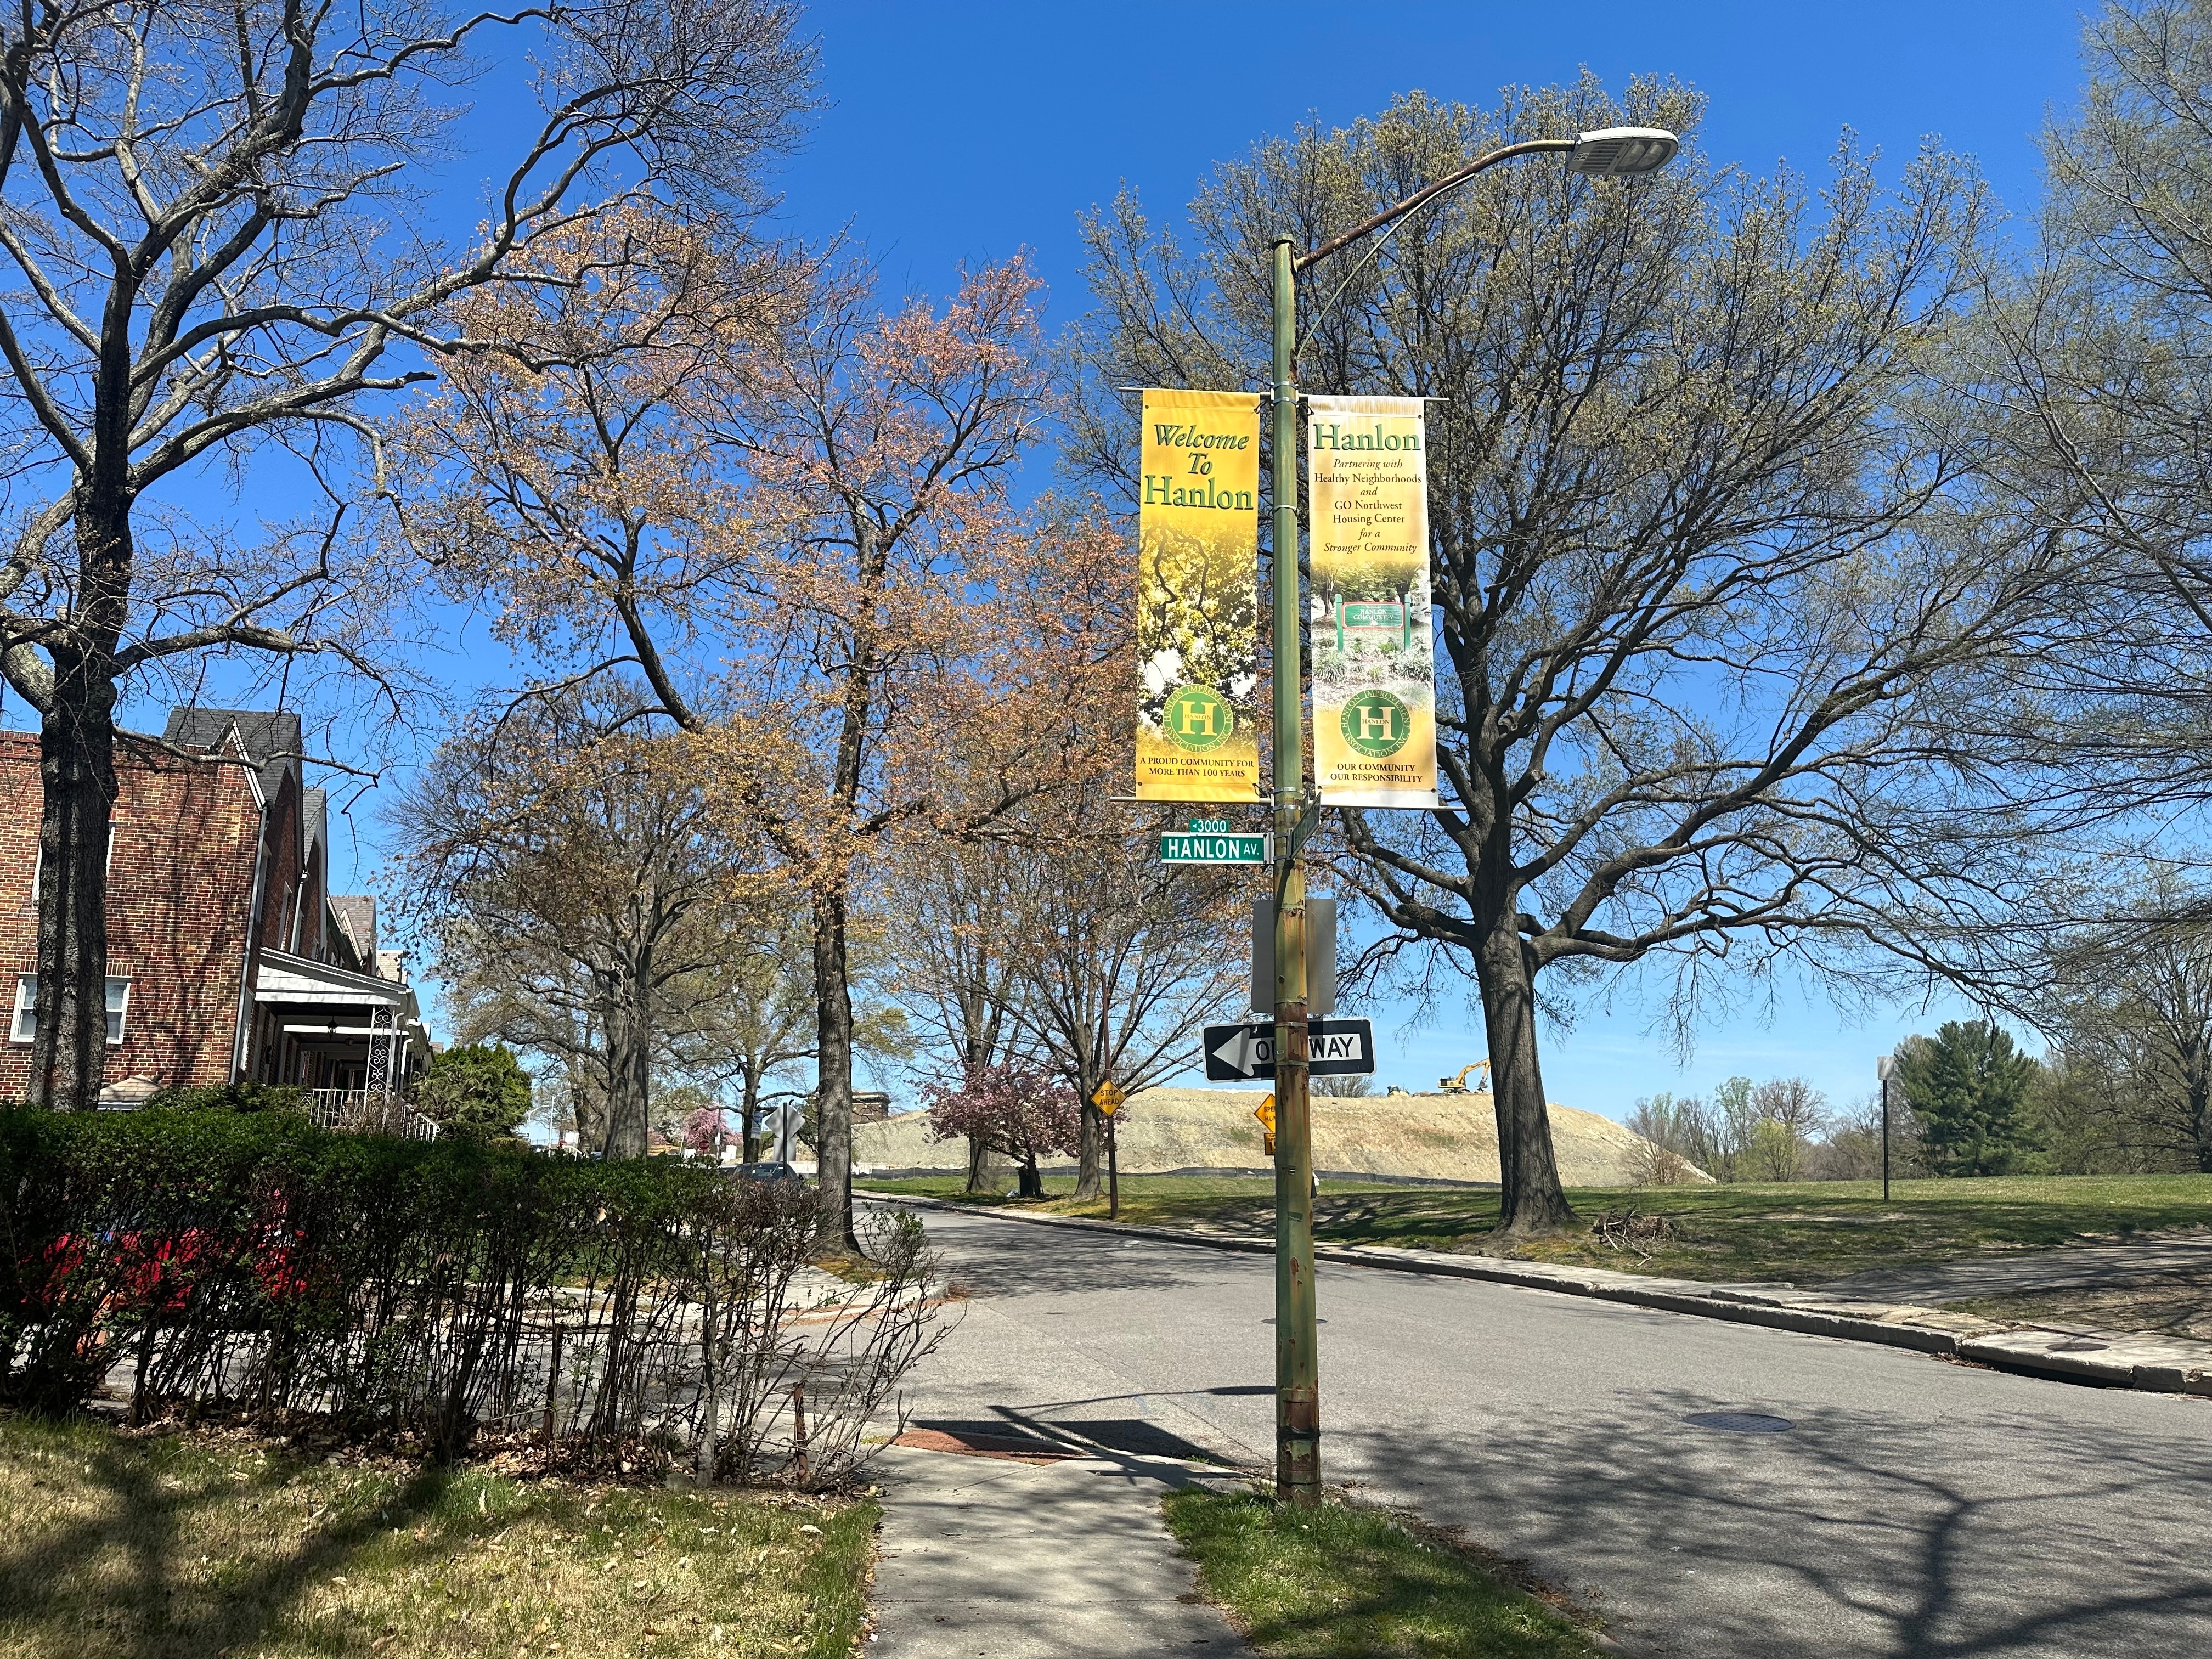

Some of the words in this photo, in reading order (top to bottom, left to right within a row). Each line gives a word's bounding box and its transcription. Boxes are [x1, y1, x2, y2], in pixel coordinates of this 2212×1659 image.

[1154, 424, 1250, 450] Welcome
[1313, 423, 1421, 450] Hanlon
[1188, 452, 1213, 475] To
[1333, 459, 1381, 470] Partnering
[1383, 459, 1403, 468] with
[1314, 473, 1350, 485] Healthy
[1352, 473, 1421, 485] Neighborhoods
[1144, 475, 1254, 510] Hanlon
[1360, 486, 1378, 496] and
[1334, 500, 1352, 510] GO
[1355, 500, 1403, 510] Northwest
[1333, 514, 1372, 526] Housing
[1374, 513, 1405, 523] Center
[1357, 528, 1373, 540] for
[1324, 543, 1362, 555] Stronger
[1364, 542, 1417, 555] Community
[1164, 689, 1184, 722] HANLON
[1187, 685, 1233, 724] IMPROVEMENT
[1341, 695, 1361, 728] HANLON
[1364, 690, 1410, 729] IMPROVEMENT
[1178, 700, 1217, 736] H
[1356, 706, 1396, 740] H
[1180, 758, 1235, 767] COMMUNITY
[1358, 763, 1416, 772] COMMUNITY
[1352, 774, 1423, 782] RESPONSIBILITY
[1197, 820, 1227, 832] 3000
[1168, 839, 1240, 859] HANLON
[1243, 843, 1260, 855] AV.
[1308, 1036, 1354, 1058] WAY
